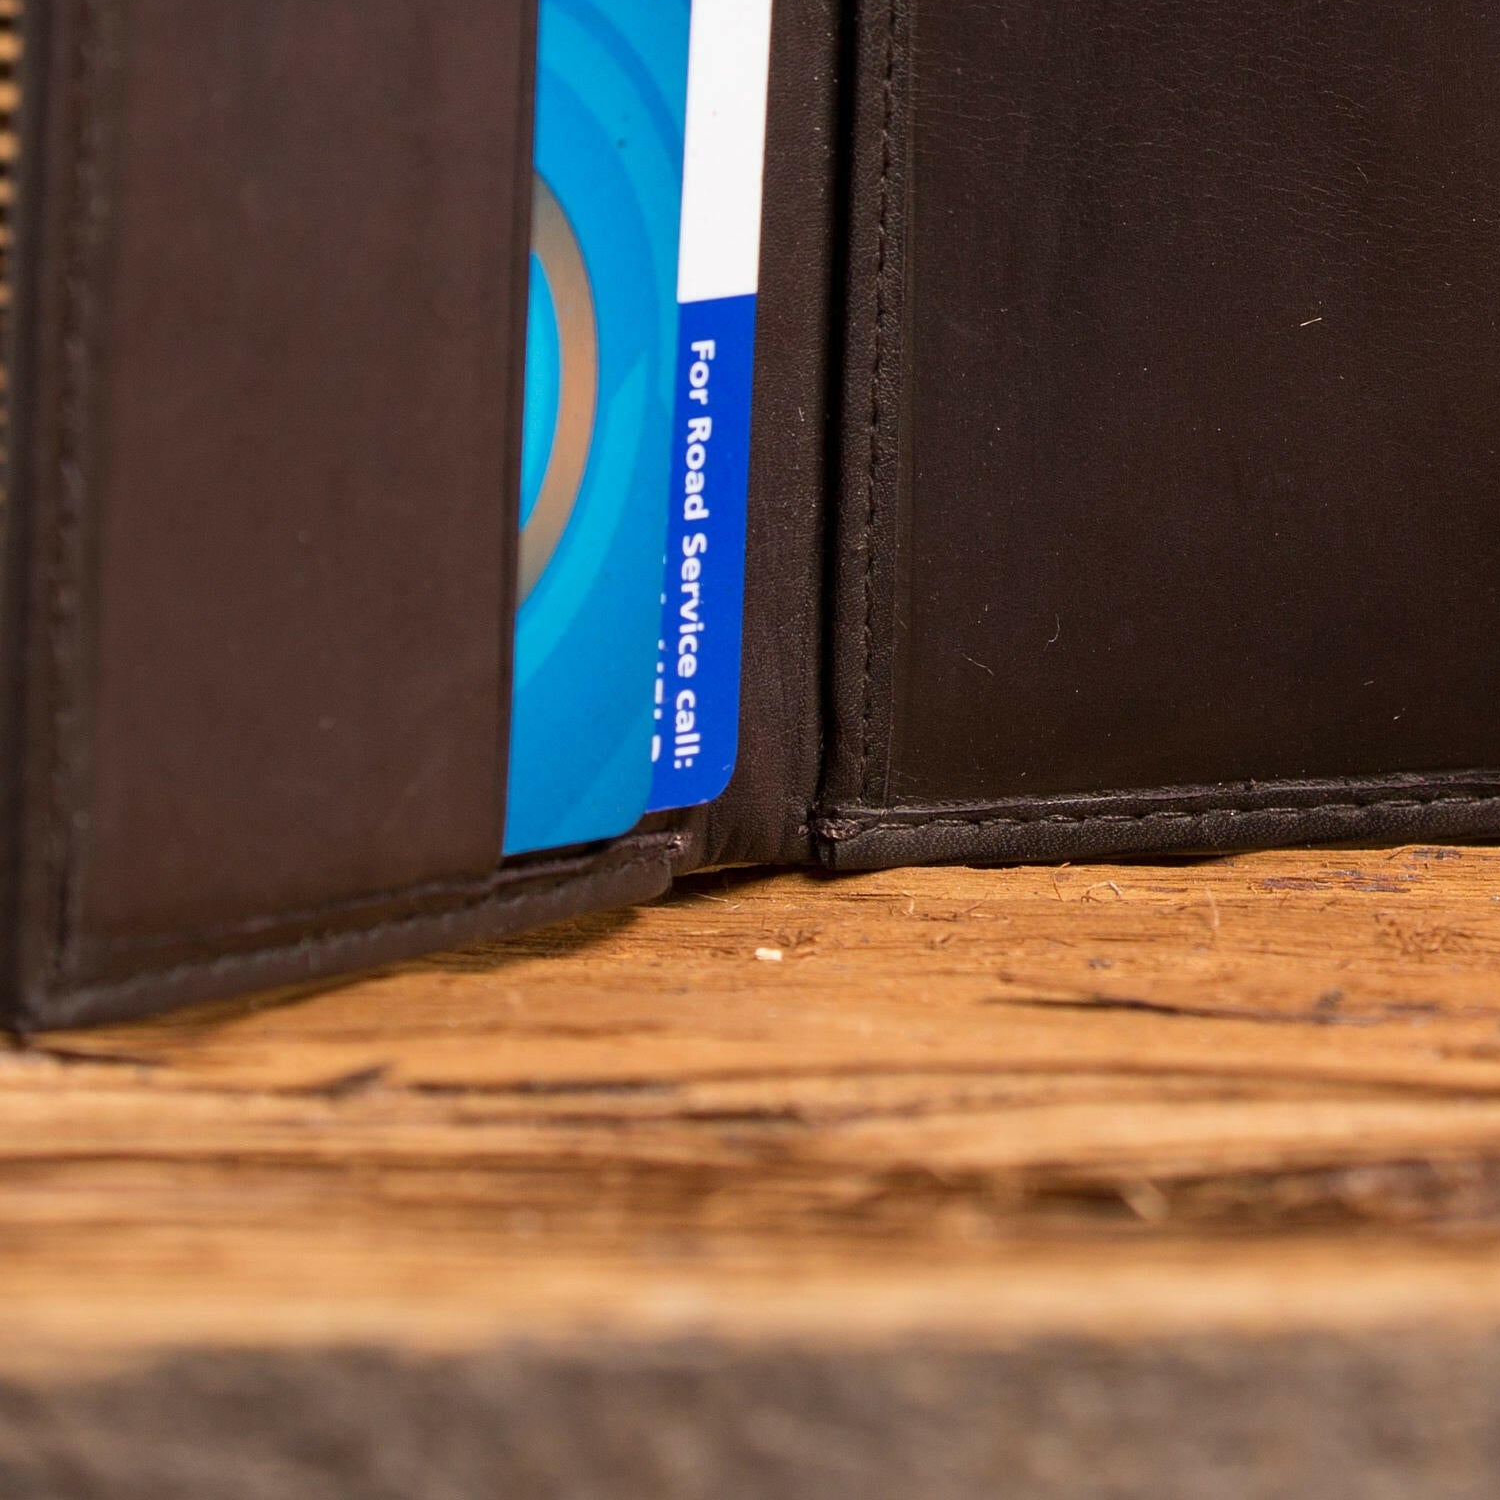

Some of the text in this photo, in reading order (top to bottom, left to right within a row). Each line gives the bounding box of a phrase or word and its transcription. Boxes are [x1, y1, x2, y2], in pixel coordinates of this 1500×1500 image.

[673, 338, 717, 770] For Road Service call:
